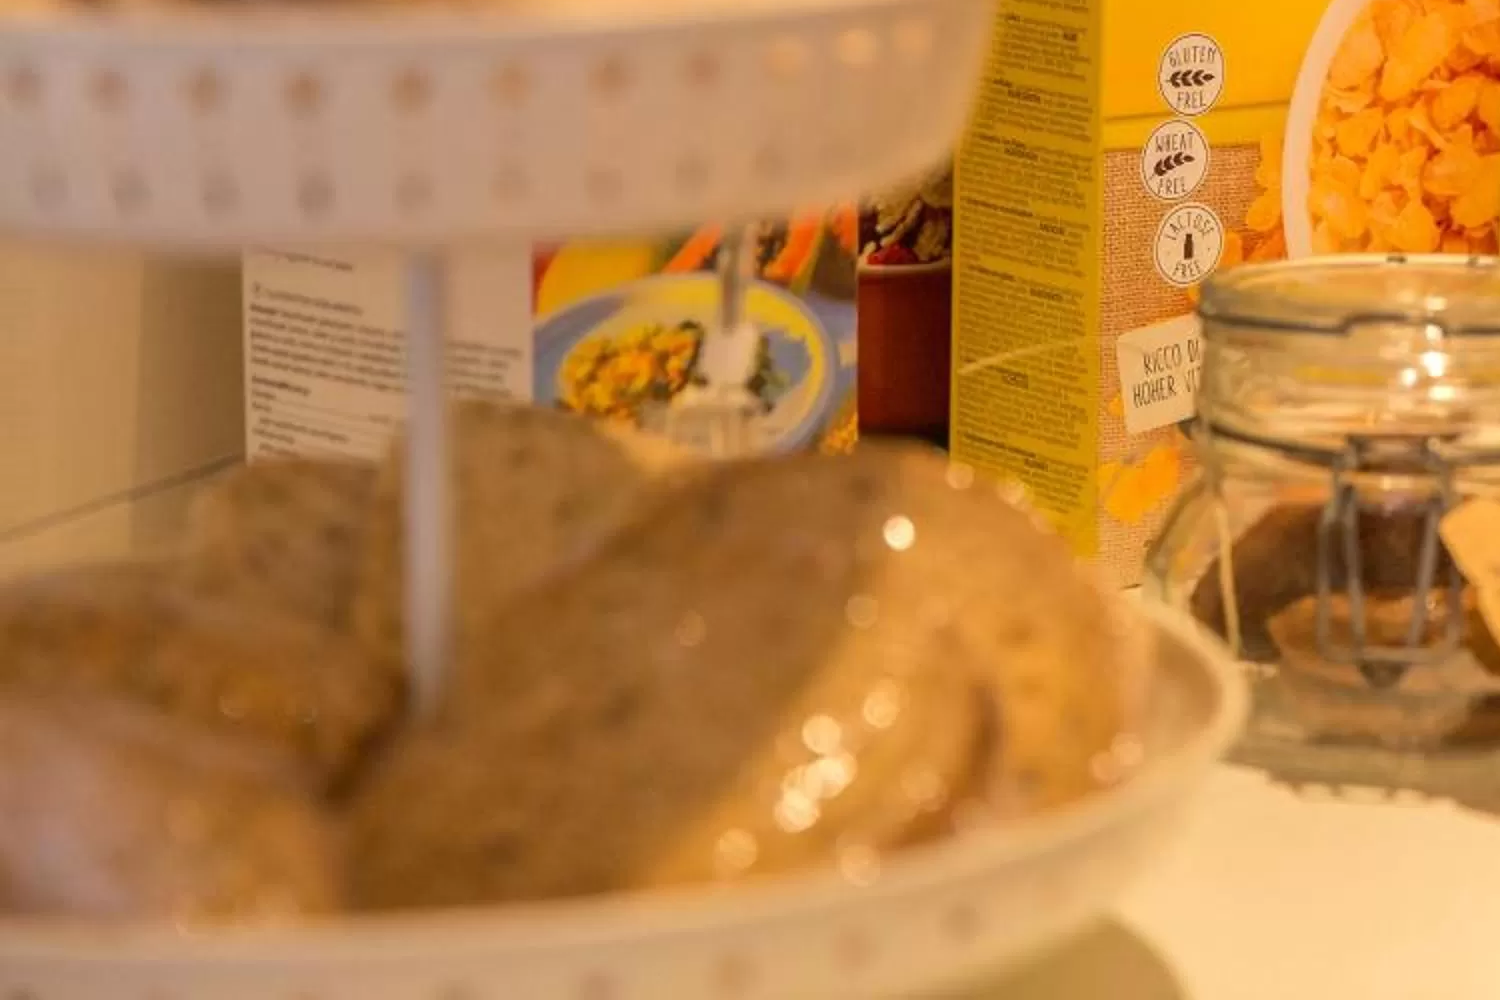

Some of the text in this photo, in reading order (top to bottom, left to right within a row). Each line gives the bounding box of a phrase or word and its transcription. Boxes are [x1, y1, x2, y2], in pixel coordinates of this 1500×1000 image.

[1168, 45, 1217, 68] GLUTEN
[1176, 90, 1207, 110] FREE
[1155, 130, 1195, 152] WHEAT
[1157, 175, 1187, 195] FREE
[1165, 210, 1215, 241] LACTOSE
[1172, 260, 1201, 278] FREE
[1143, 343, 1182, 376] RICCO
[1133, 374, 1177, 409] HOHER
